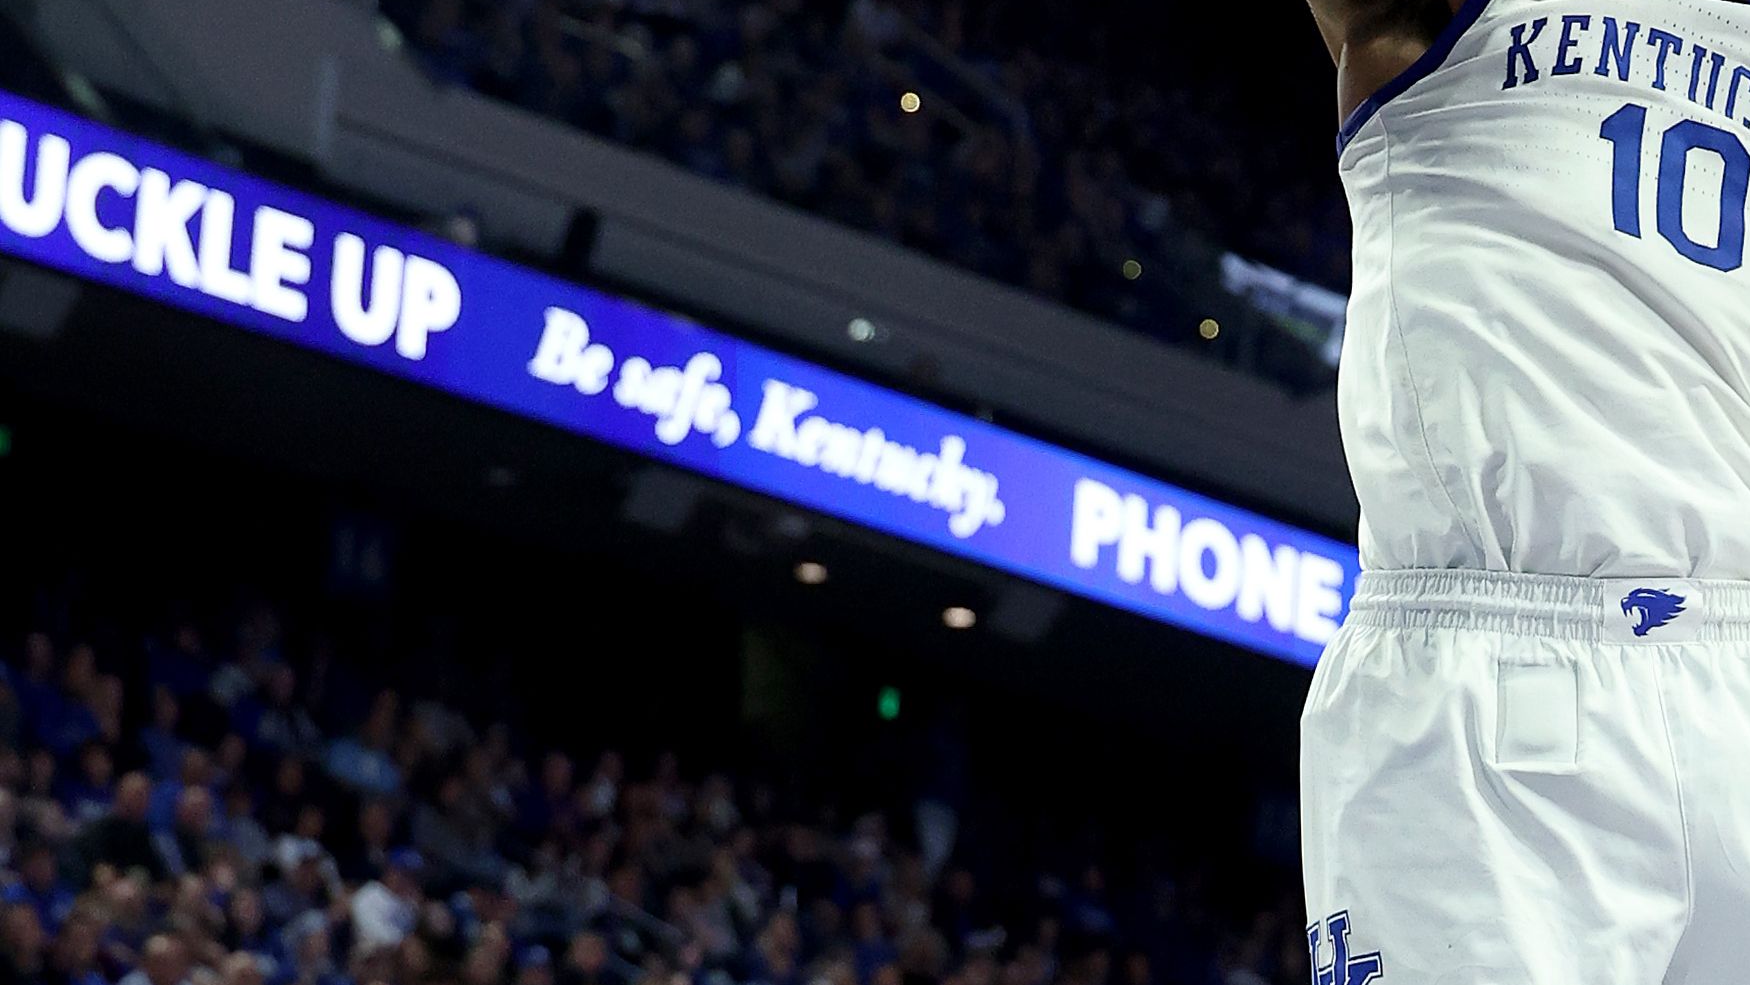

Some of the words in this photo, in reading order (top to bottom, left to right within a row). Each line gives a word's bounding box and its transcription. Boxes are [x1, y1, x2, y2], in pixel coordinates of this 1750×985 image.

[0, 118, 315, 322] UCKLE
[331, 232, 462, 361] UP
[529, 306, 615, 395] Be
[1070, 476, 1345, 646] PHONE
